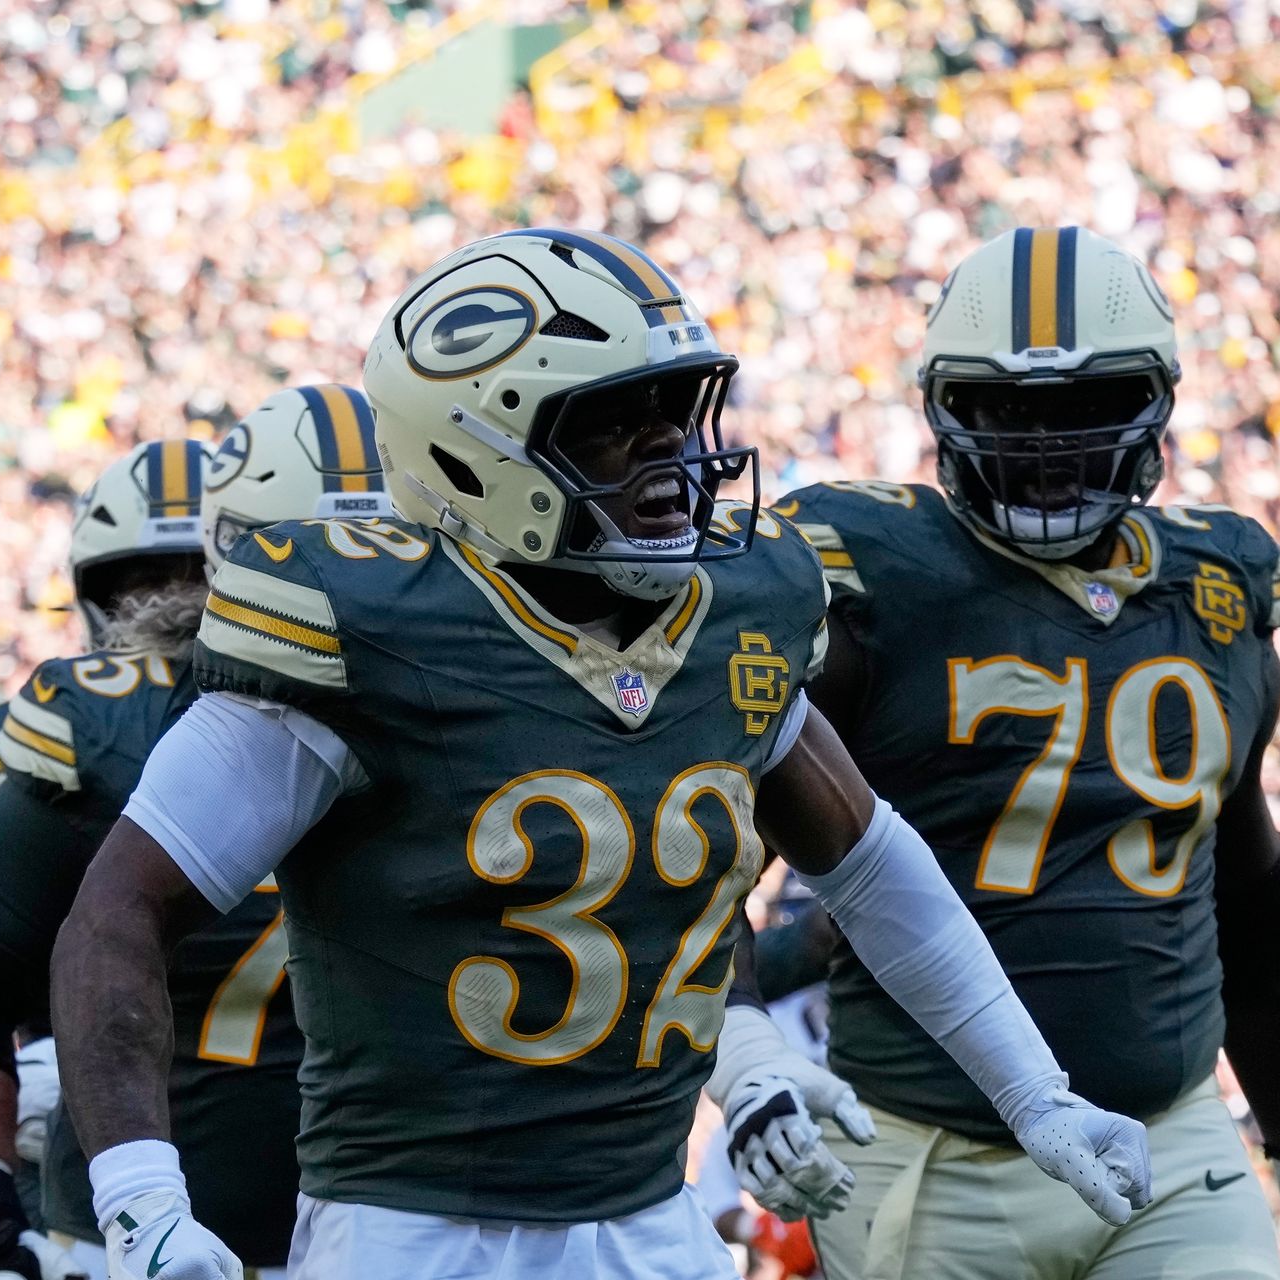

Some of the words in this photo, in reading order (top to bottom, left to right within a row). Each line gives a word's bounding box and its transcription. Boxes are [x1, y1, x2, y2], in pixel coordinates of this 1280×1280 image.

[621, 689, 646, 708] NFL
[947, 655, 1231, 896] 79
[448, 761, 765, 1068] 32
